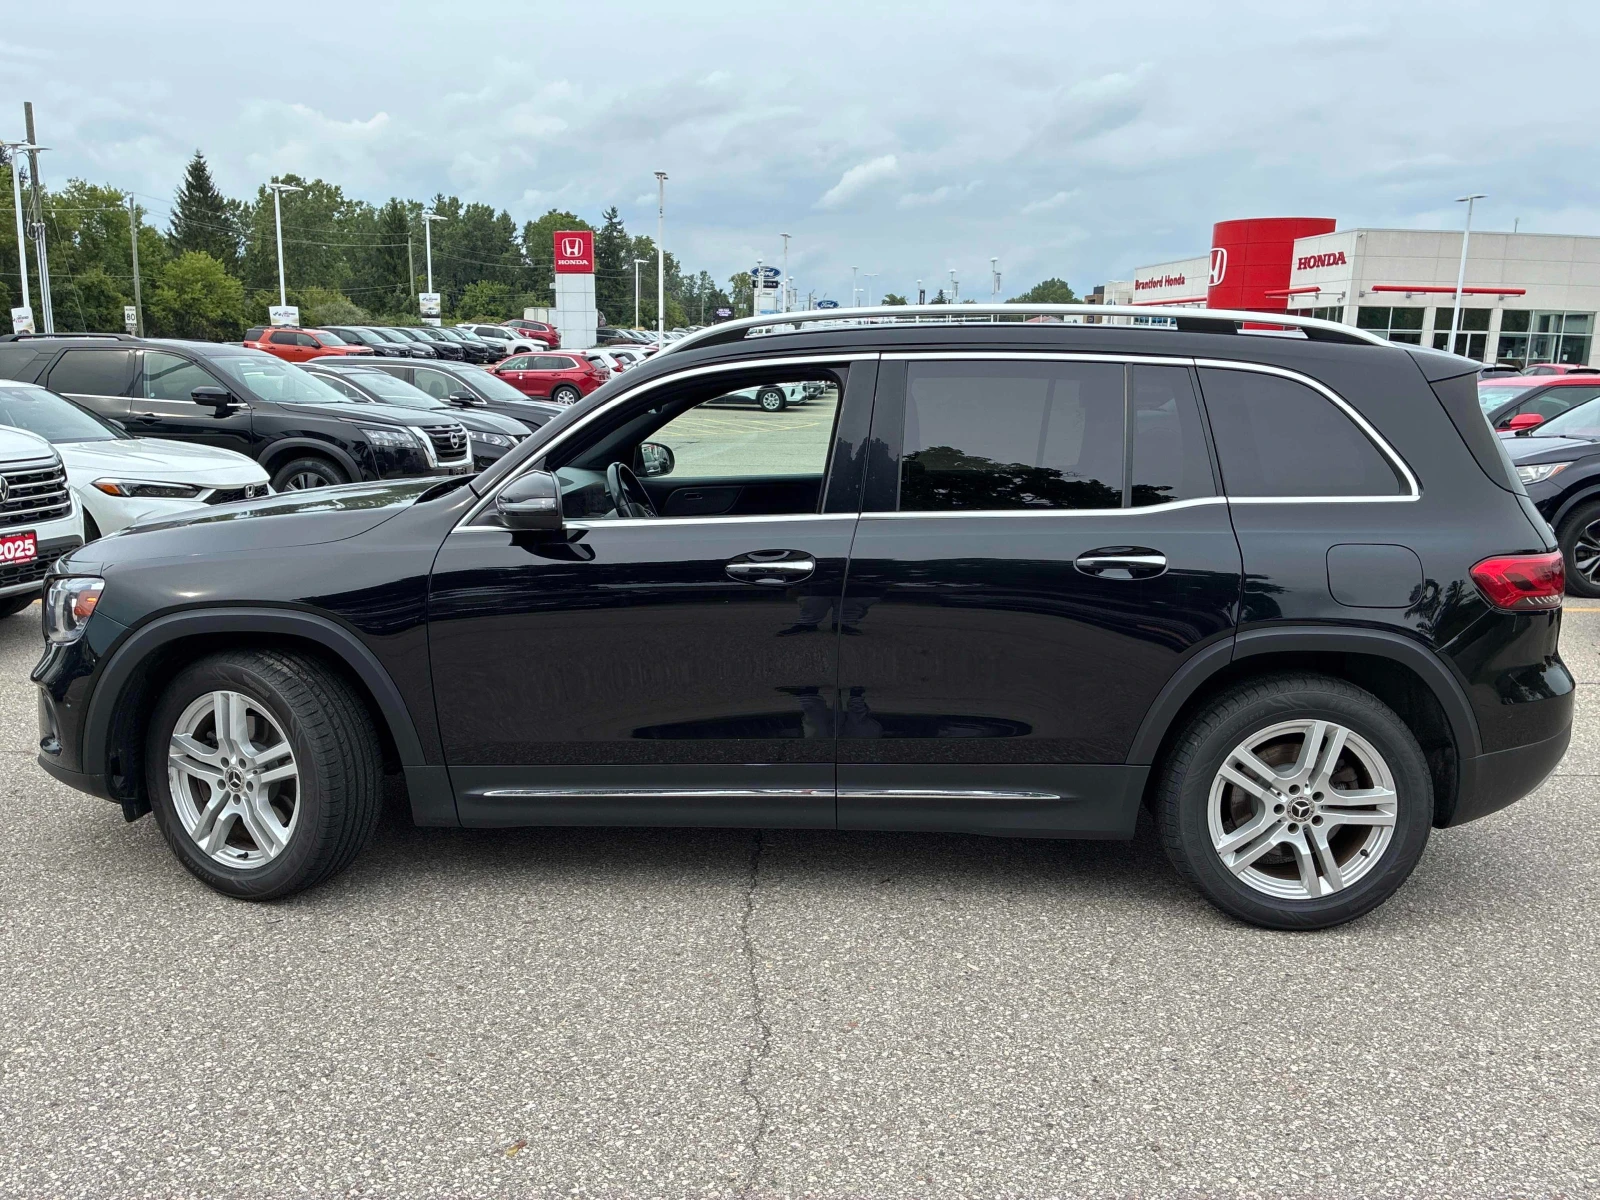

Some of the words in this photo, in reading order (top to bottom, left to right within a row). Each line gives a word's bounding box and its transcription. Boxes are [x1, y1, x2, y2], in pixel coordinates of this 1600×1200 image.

[1297, 251, 1347, 271] HONDA
[1134, 276, 1164, 291] Brantford
[1164, 273, 1186, 287] Honda
[126, 312, 136, 321] 80
